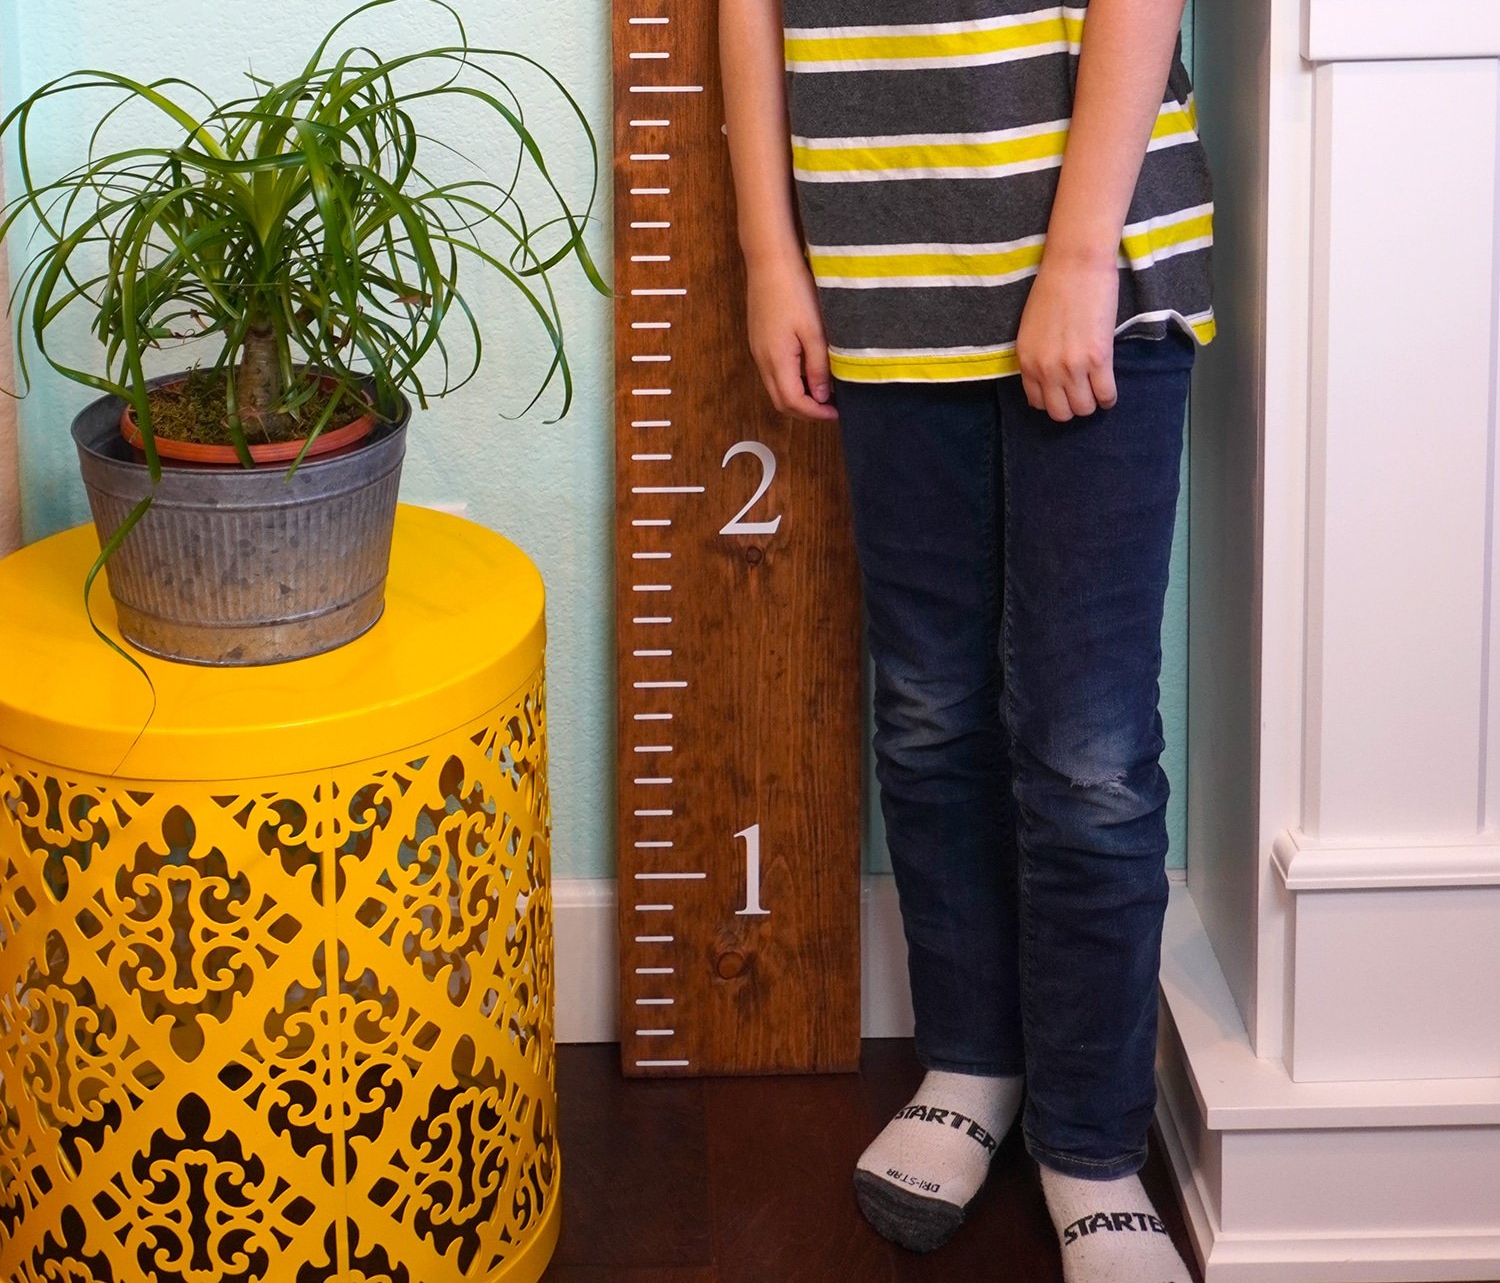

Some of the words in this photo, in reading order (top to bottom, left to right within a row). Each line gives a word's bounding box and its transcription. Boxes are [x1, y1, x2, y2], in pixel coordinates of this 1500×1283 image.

[719, 441, 782, 534] 2
[733, 824, 771, 915] 1
[886, 1168, 941, 1193] DRI-STAR
[1063, 1212, 1167, 1246] STARTE
